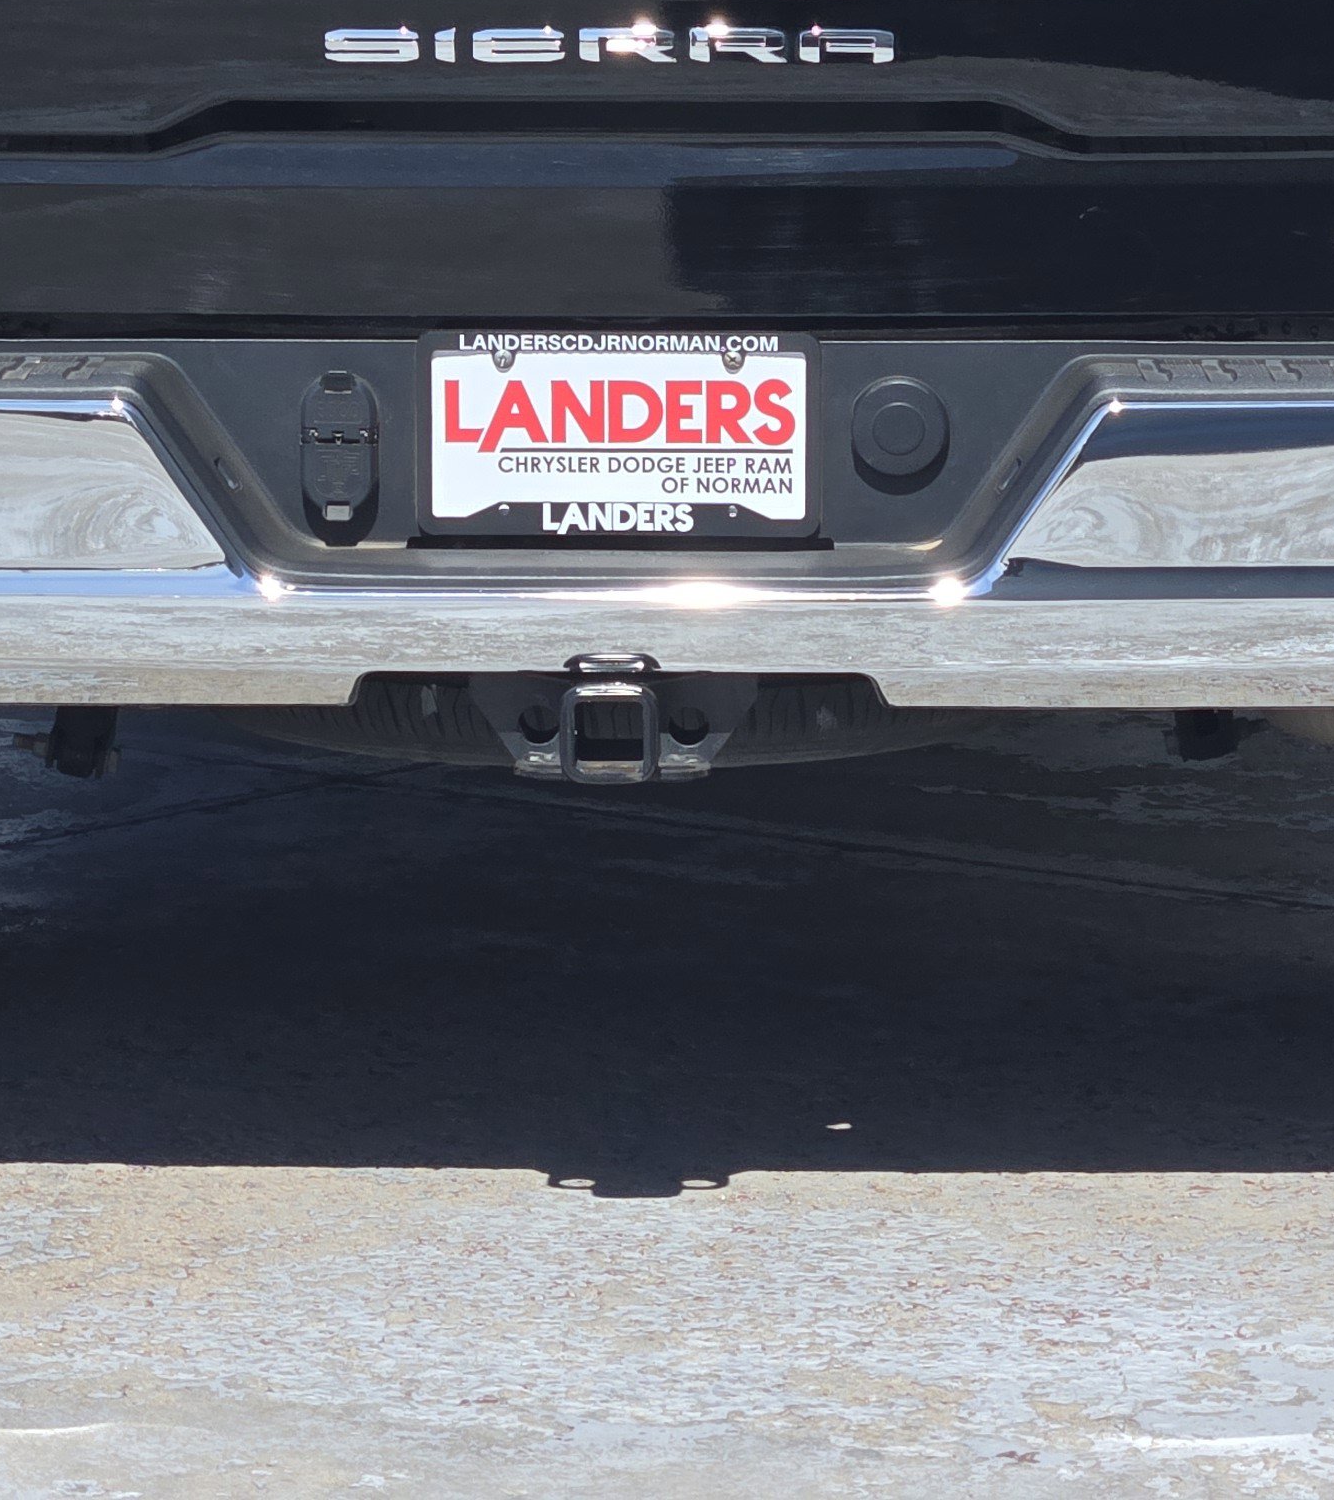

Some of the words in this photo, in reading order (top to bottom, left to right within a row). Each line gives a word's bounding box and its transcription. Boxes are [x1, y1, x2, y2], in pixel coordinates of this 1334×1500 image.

[324, 26, 895, 64] SIERRA
[459, 333, 779, 353] LANDERSCDJRNORMAN.COM
[444, 378, 796, 453] LANDERS
[497, 456, 600, 474] CHRYSLER
[607, 456, 685, 474] DODGE
[692, 457, 736, 474] JEEP
[745, 457, 792, 475] RAM
[661, 477, 689, 494] OF
[696, 477, 793, 494] NORMAN
[542, 503, 694, 535] LANDERS
